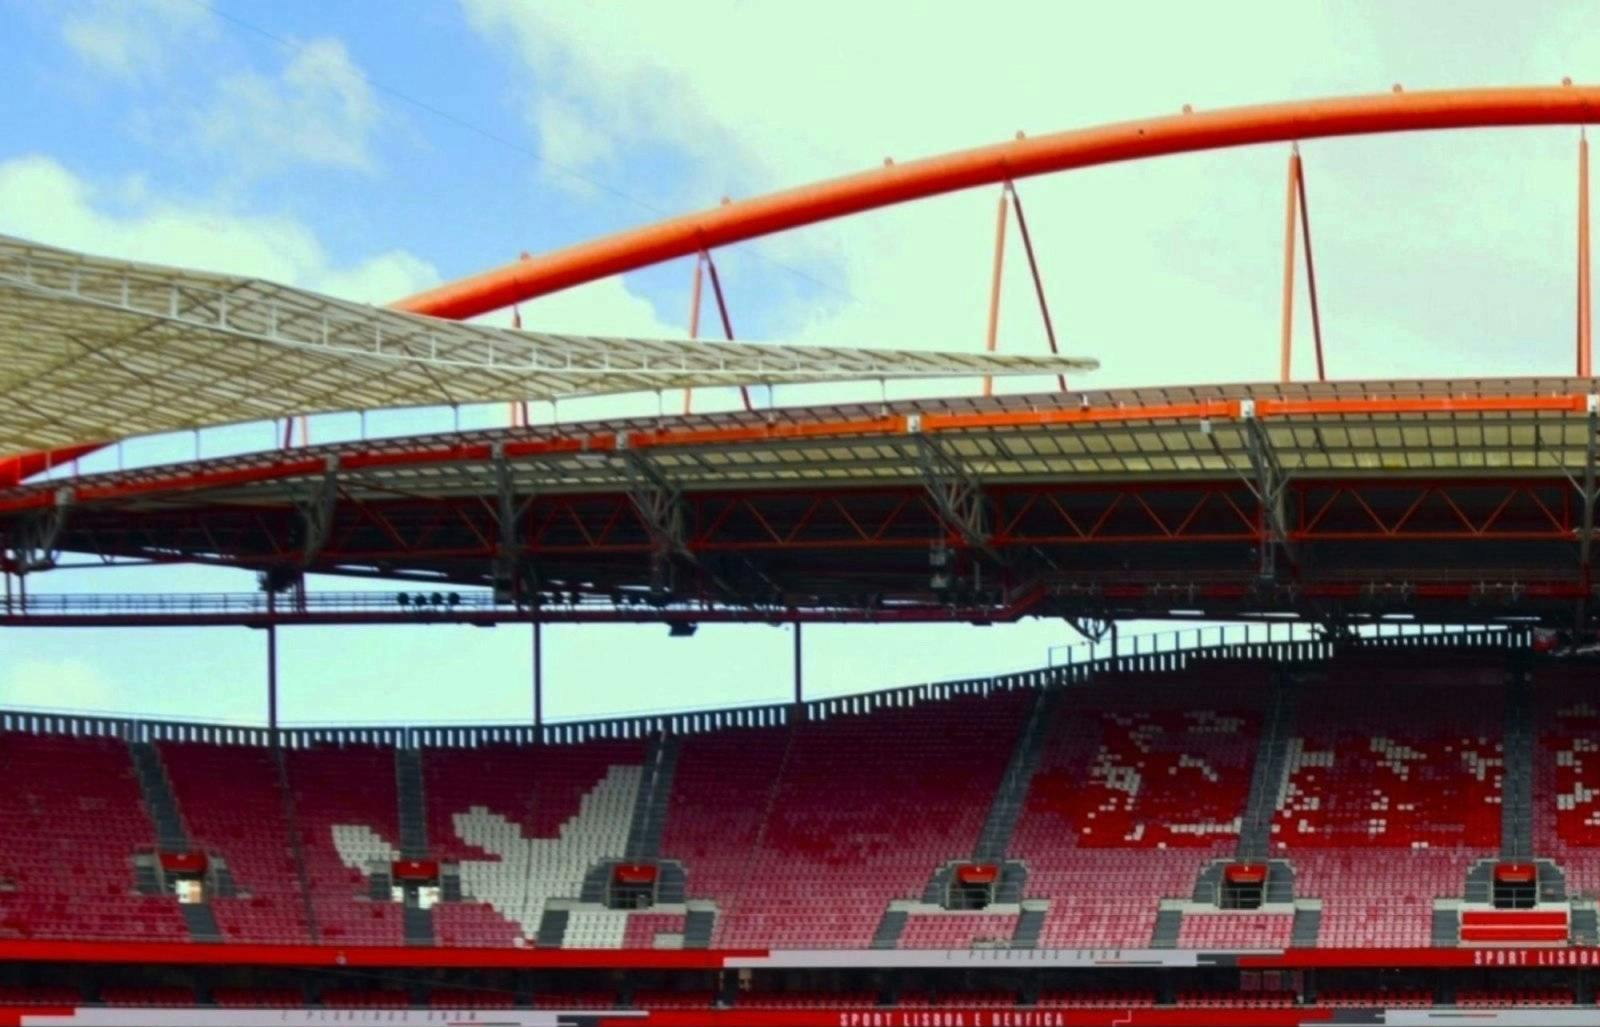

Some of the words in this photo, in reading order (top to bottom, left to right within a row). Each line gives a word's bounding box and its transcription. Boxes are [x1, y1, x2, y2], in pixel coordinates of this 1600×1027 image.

[1474, 950, 1528, 966] SPORT
[1538, 950, 1600, 966] LISBOA
[840, 1012, 892, 1027] SPORT
[903, 1012, 964, 1027] LISBOA
[975, 1012, 982, 1027] E
[992, 1012, 1065, 1027] BENFICA
